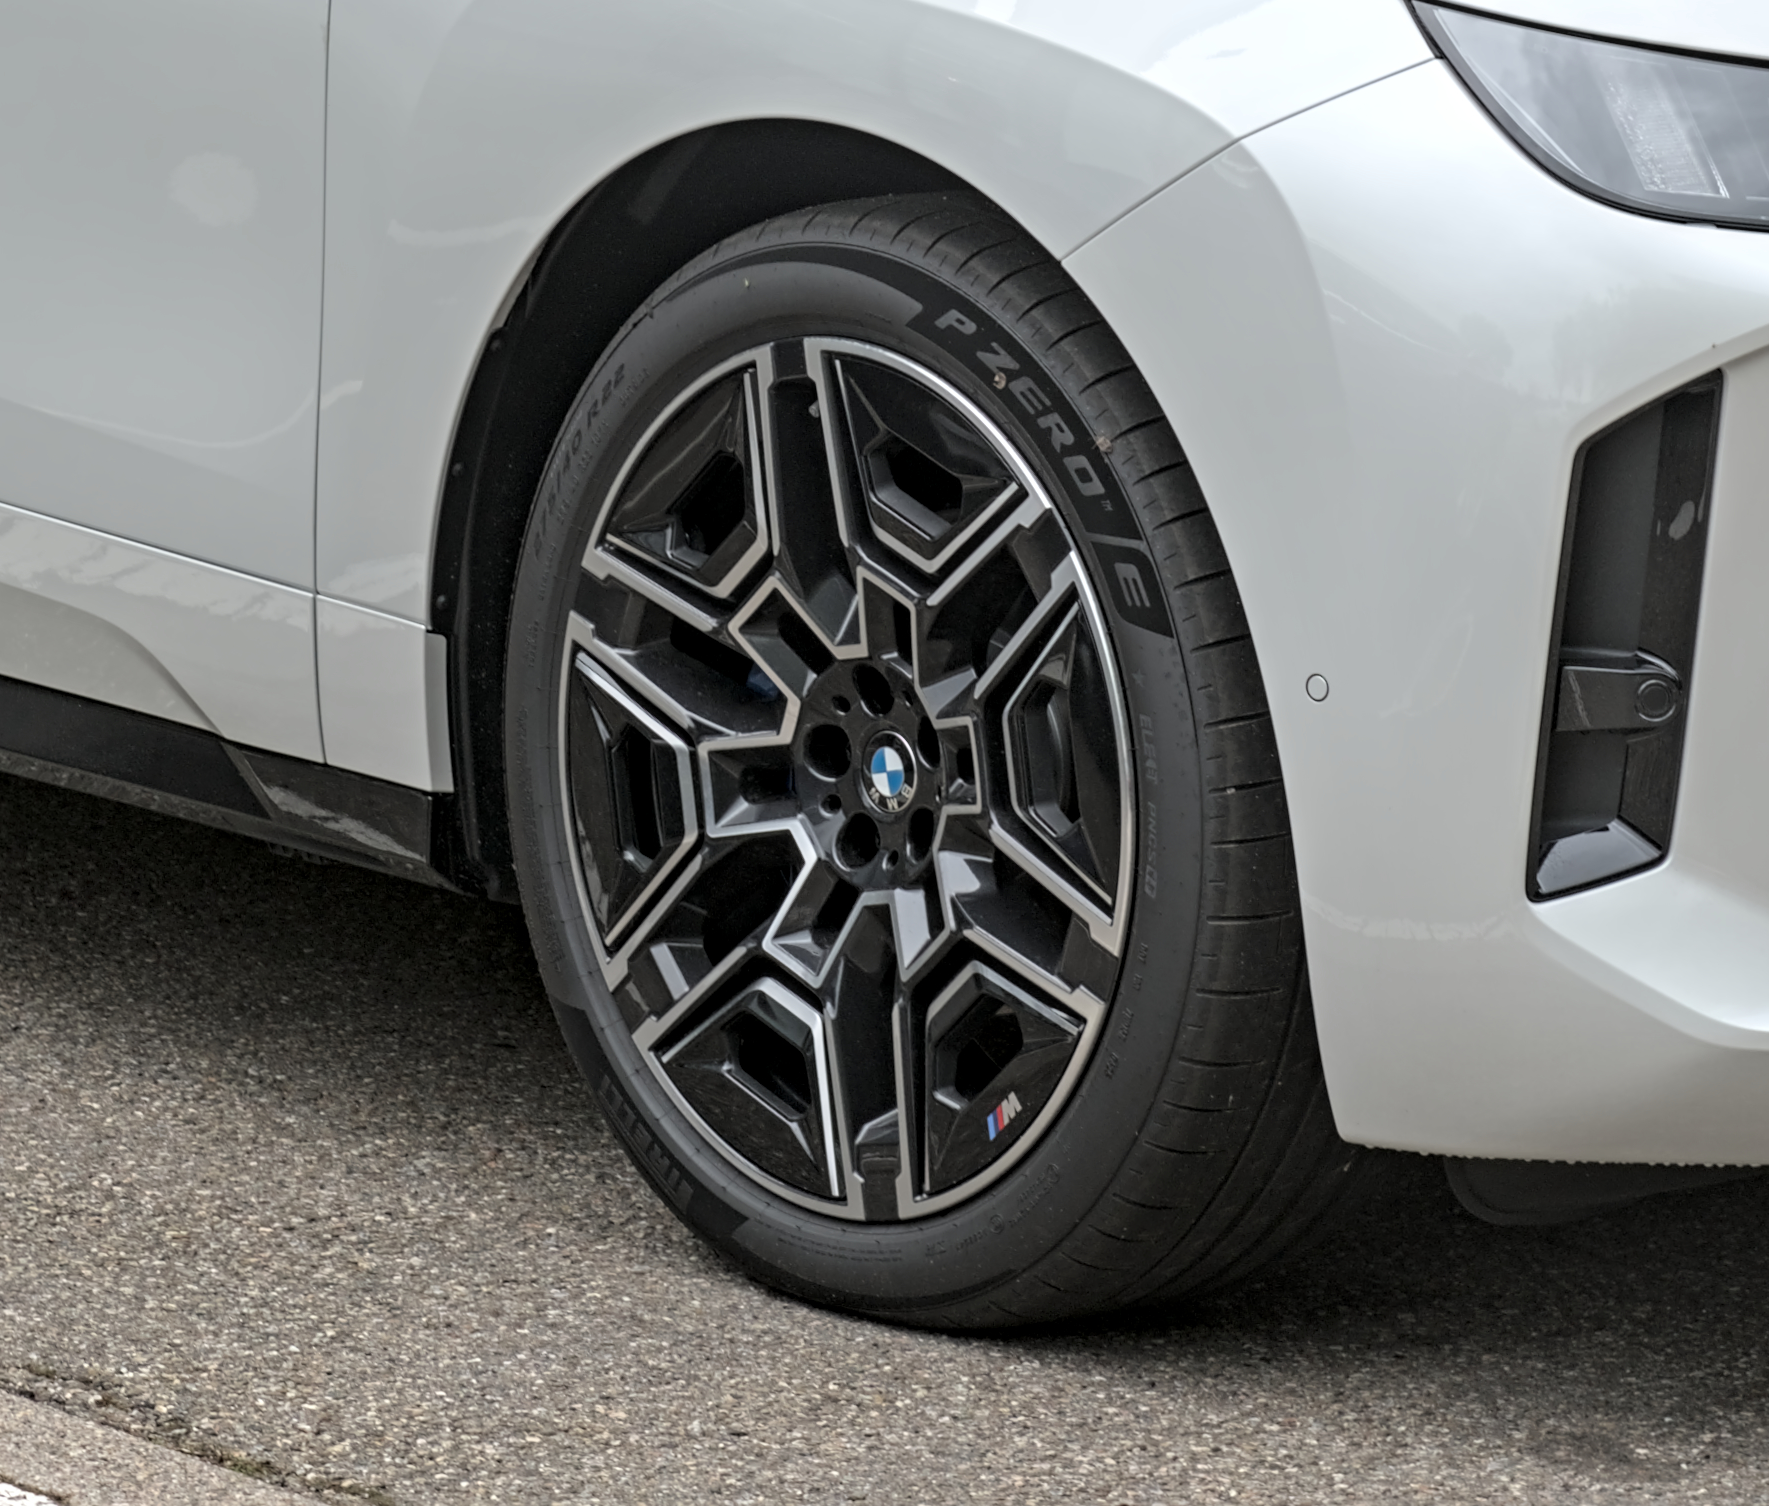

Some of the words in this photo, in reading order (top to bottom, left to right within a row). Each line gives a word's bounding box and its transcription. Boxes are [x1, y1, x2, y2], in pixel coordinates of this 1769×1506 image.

[586, 362, 625, 430] R22
[934, 309, 977, 335] P
[976, 342, 1106, 497] ZERO
[1114, 562, 1151, 608] E
[869, 783, 912, 811] BMW
